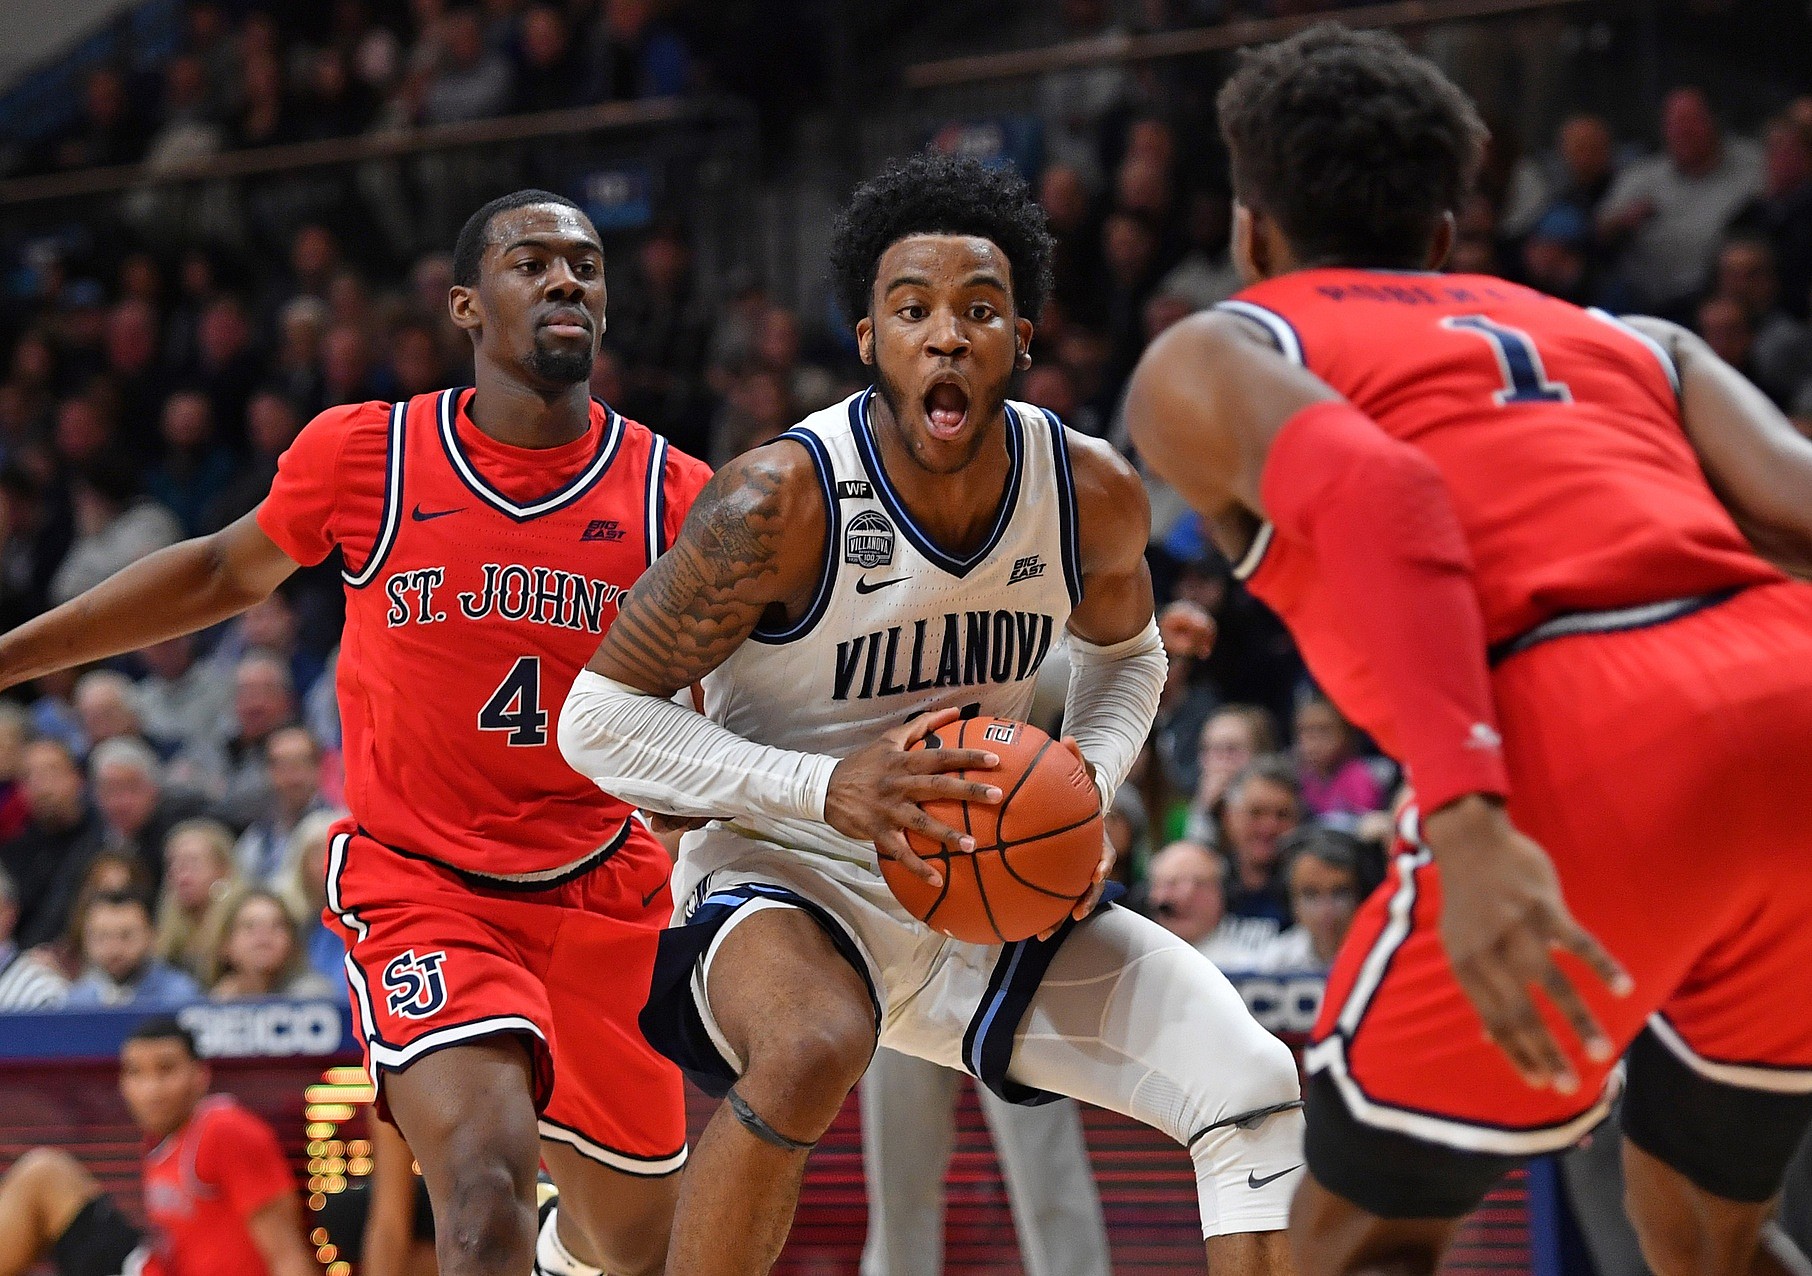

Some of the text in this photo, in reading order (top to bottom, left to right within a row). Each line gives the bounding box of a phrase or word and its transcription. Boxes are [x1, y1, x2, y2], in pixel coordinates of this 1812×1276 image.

[1438, 314, 1574, 408] 1
[845, 482, 867, 496] WF
[589, 519, 620, 530] BIG
[582, 529, 627, 541] EAST
[850, 536, 888, 554] VILLANOVA
[1013, 554, 1040, 570] BIG
[1009, 563, 1048, 580] EAST
[386, 566, 447, 628] ST.
[457, 563, 630, 635] JOHN'
[477, 656, 548, 747] 4
